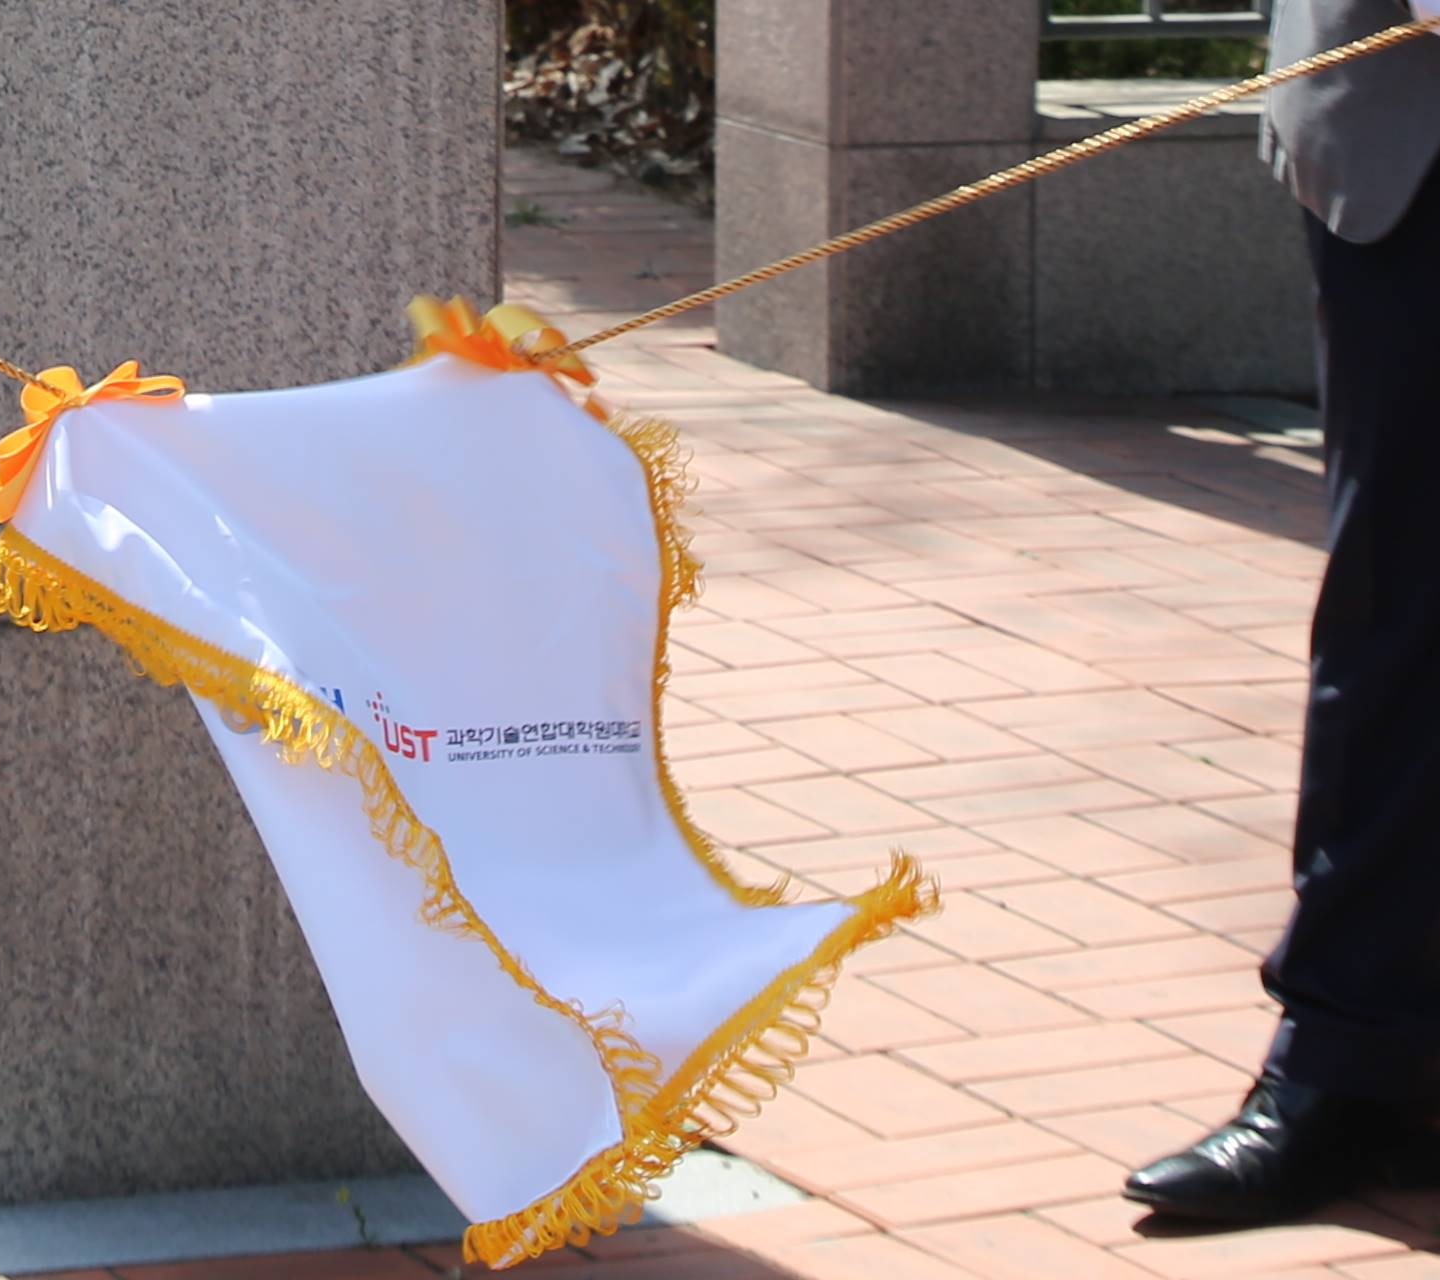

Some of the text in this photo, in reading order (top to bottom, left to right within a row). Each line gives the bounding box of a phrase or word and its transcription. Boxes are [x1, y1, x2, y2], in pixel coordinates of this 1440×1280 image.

[382, 717, 438, 762] UST
[448, 748, 514, 762] UNIVERSITY
[517, 747, 532, 758] OF
[535, 743, 579, 757] SCIENCE
